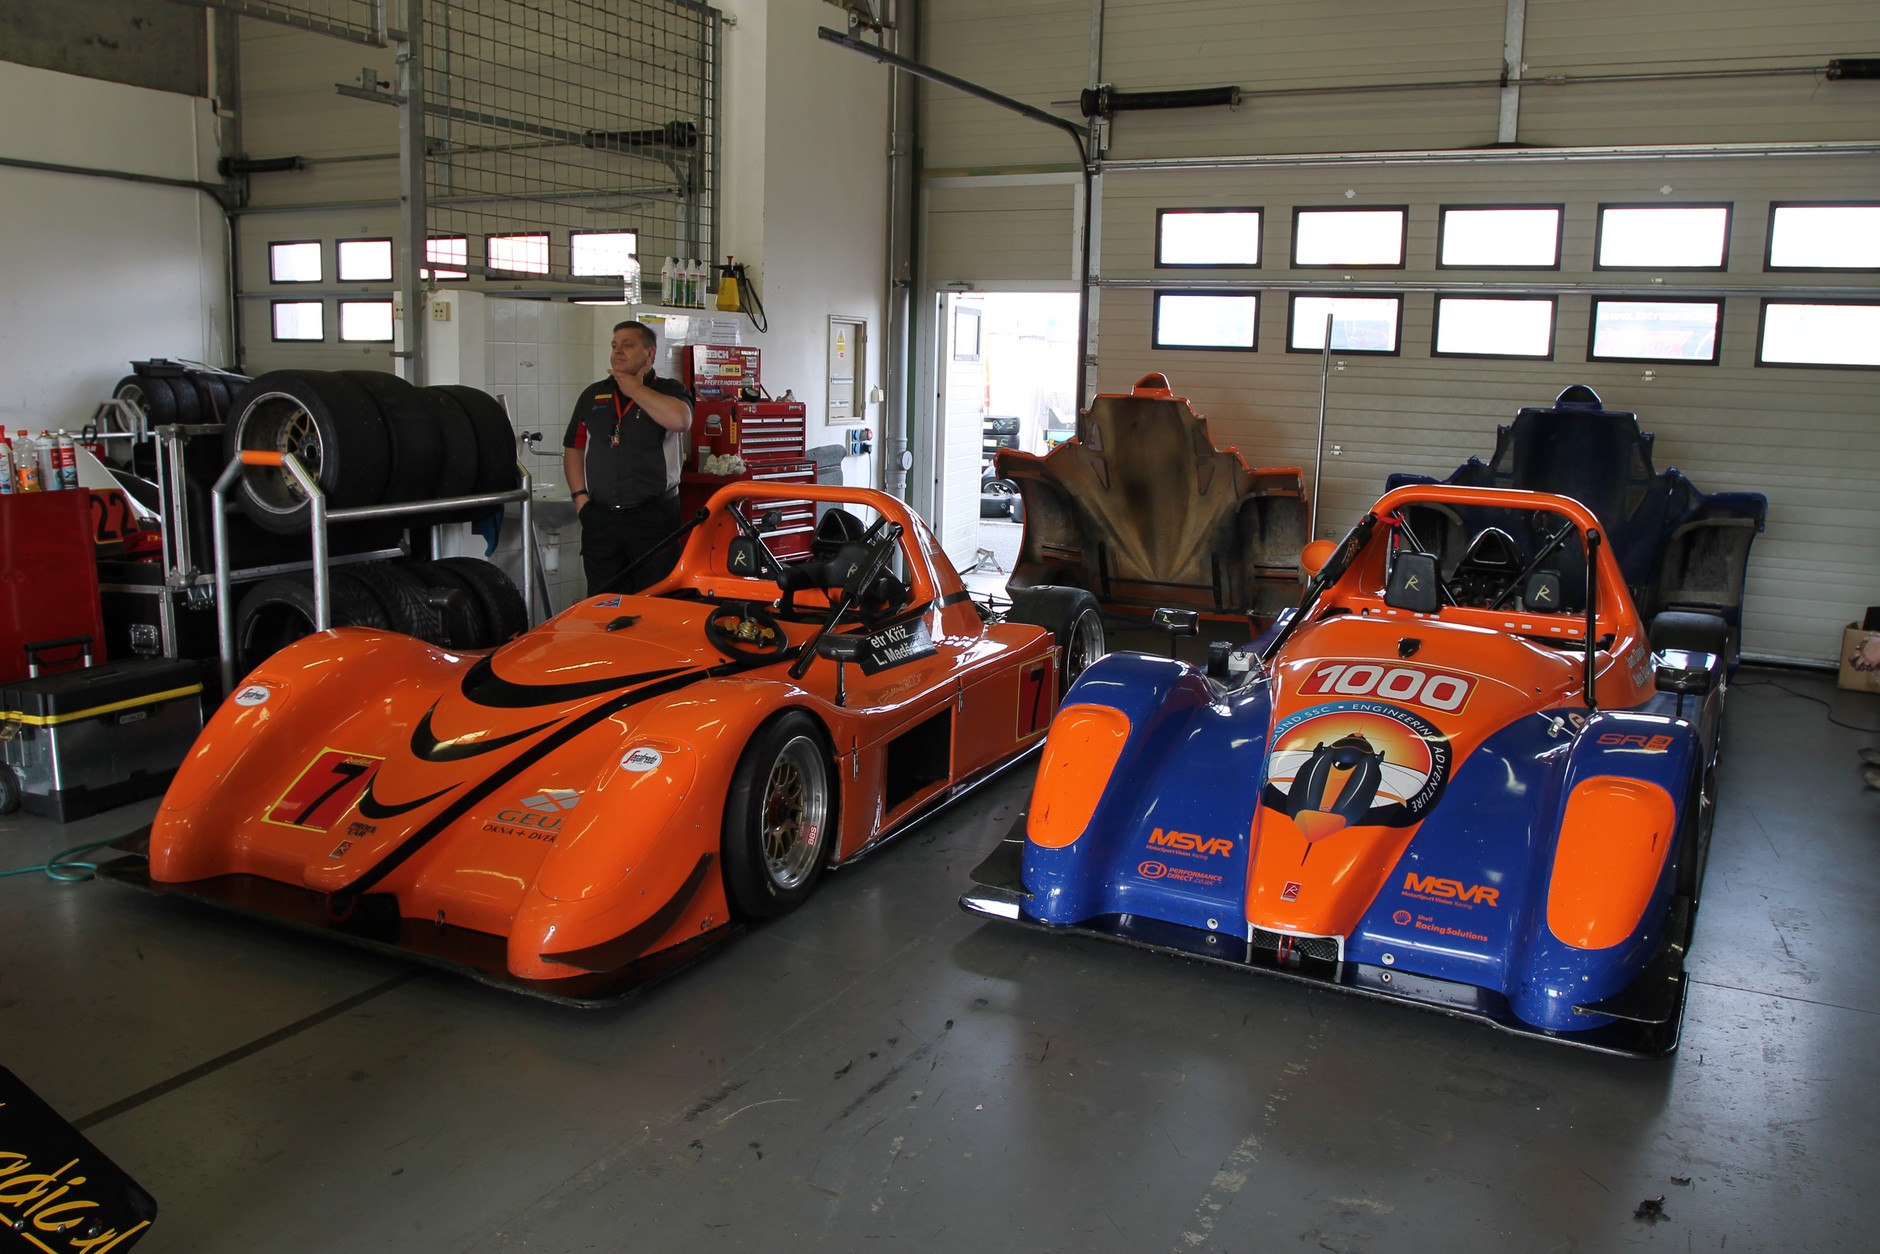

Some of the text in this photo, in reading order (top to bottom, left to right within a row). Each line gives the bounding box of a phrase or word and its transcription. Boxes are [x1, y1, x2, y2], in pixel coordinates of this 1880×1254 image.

[89, 492, 138, 541] 22
[1404, 574, 1420, 592] R
[1534, 584, 1551, 602] R
[866, 634, 888, 649] etr
[1316, 664, 1469, 711] 1000
[1030, 667, 1046, 732] 7
[1305, 705, 1331, 718] SSC
[1352, 703, 1438, 742] ENGINEERING
[1411, 746, 1446, 813] ADVENTURE
[294, 763, 370, 825] 7
[482, 824, 514, 836] OKNA
[496, 809, 562, 831] GEU
[807, 826, 817, 846] BBS
[1148, 827, 1234, 858] MSVR
[1168, 867, 1223, 882] PERFORMANCE
[1403, 872, 1500, 908] MSVR
[1417, 914, 1433, 922] Shell
[1415, 920, 1489, 942] Racing Solutions
